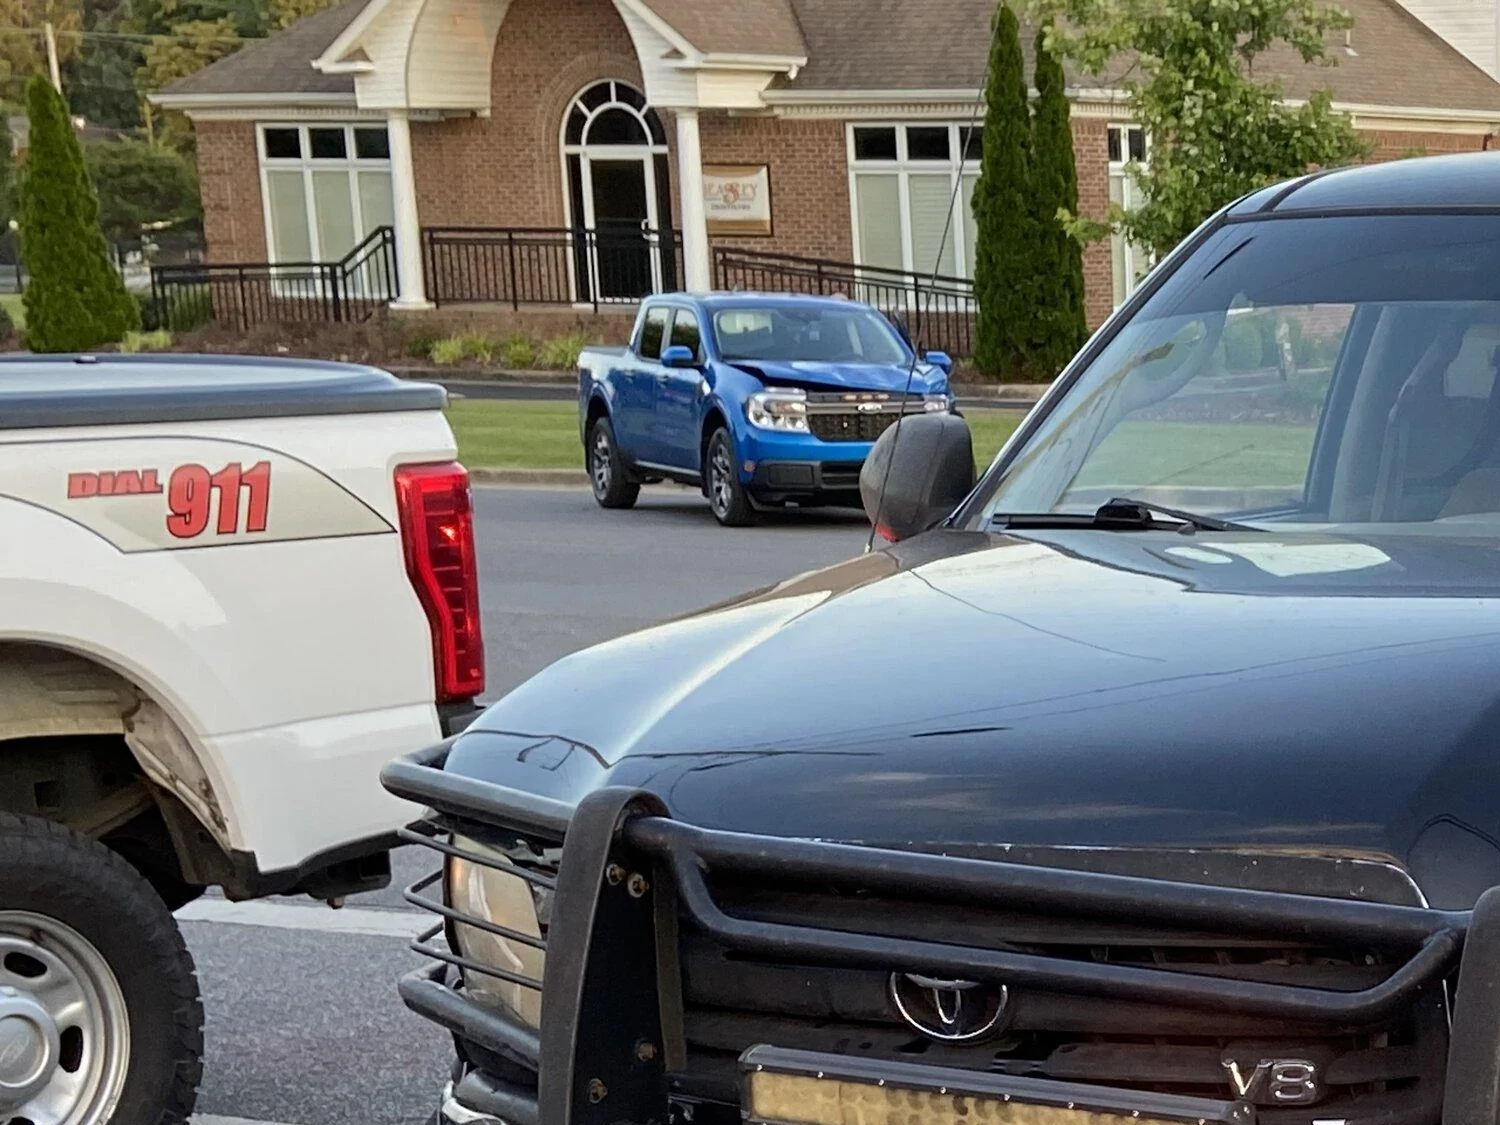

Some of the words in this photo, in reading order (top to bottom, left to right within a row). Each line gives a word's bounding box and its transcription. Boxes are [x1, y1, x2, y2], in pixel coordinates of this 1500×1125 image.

[67, 469, 164, 499] DIAL
[166, 461, 271, 539] 911
[1221, 1058, 1318, 1104] V8
